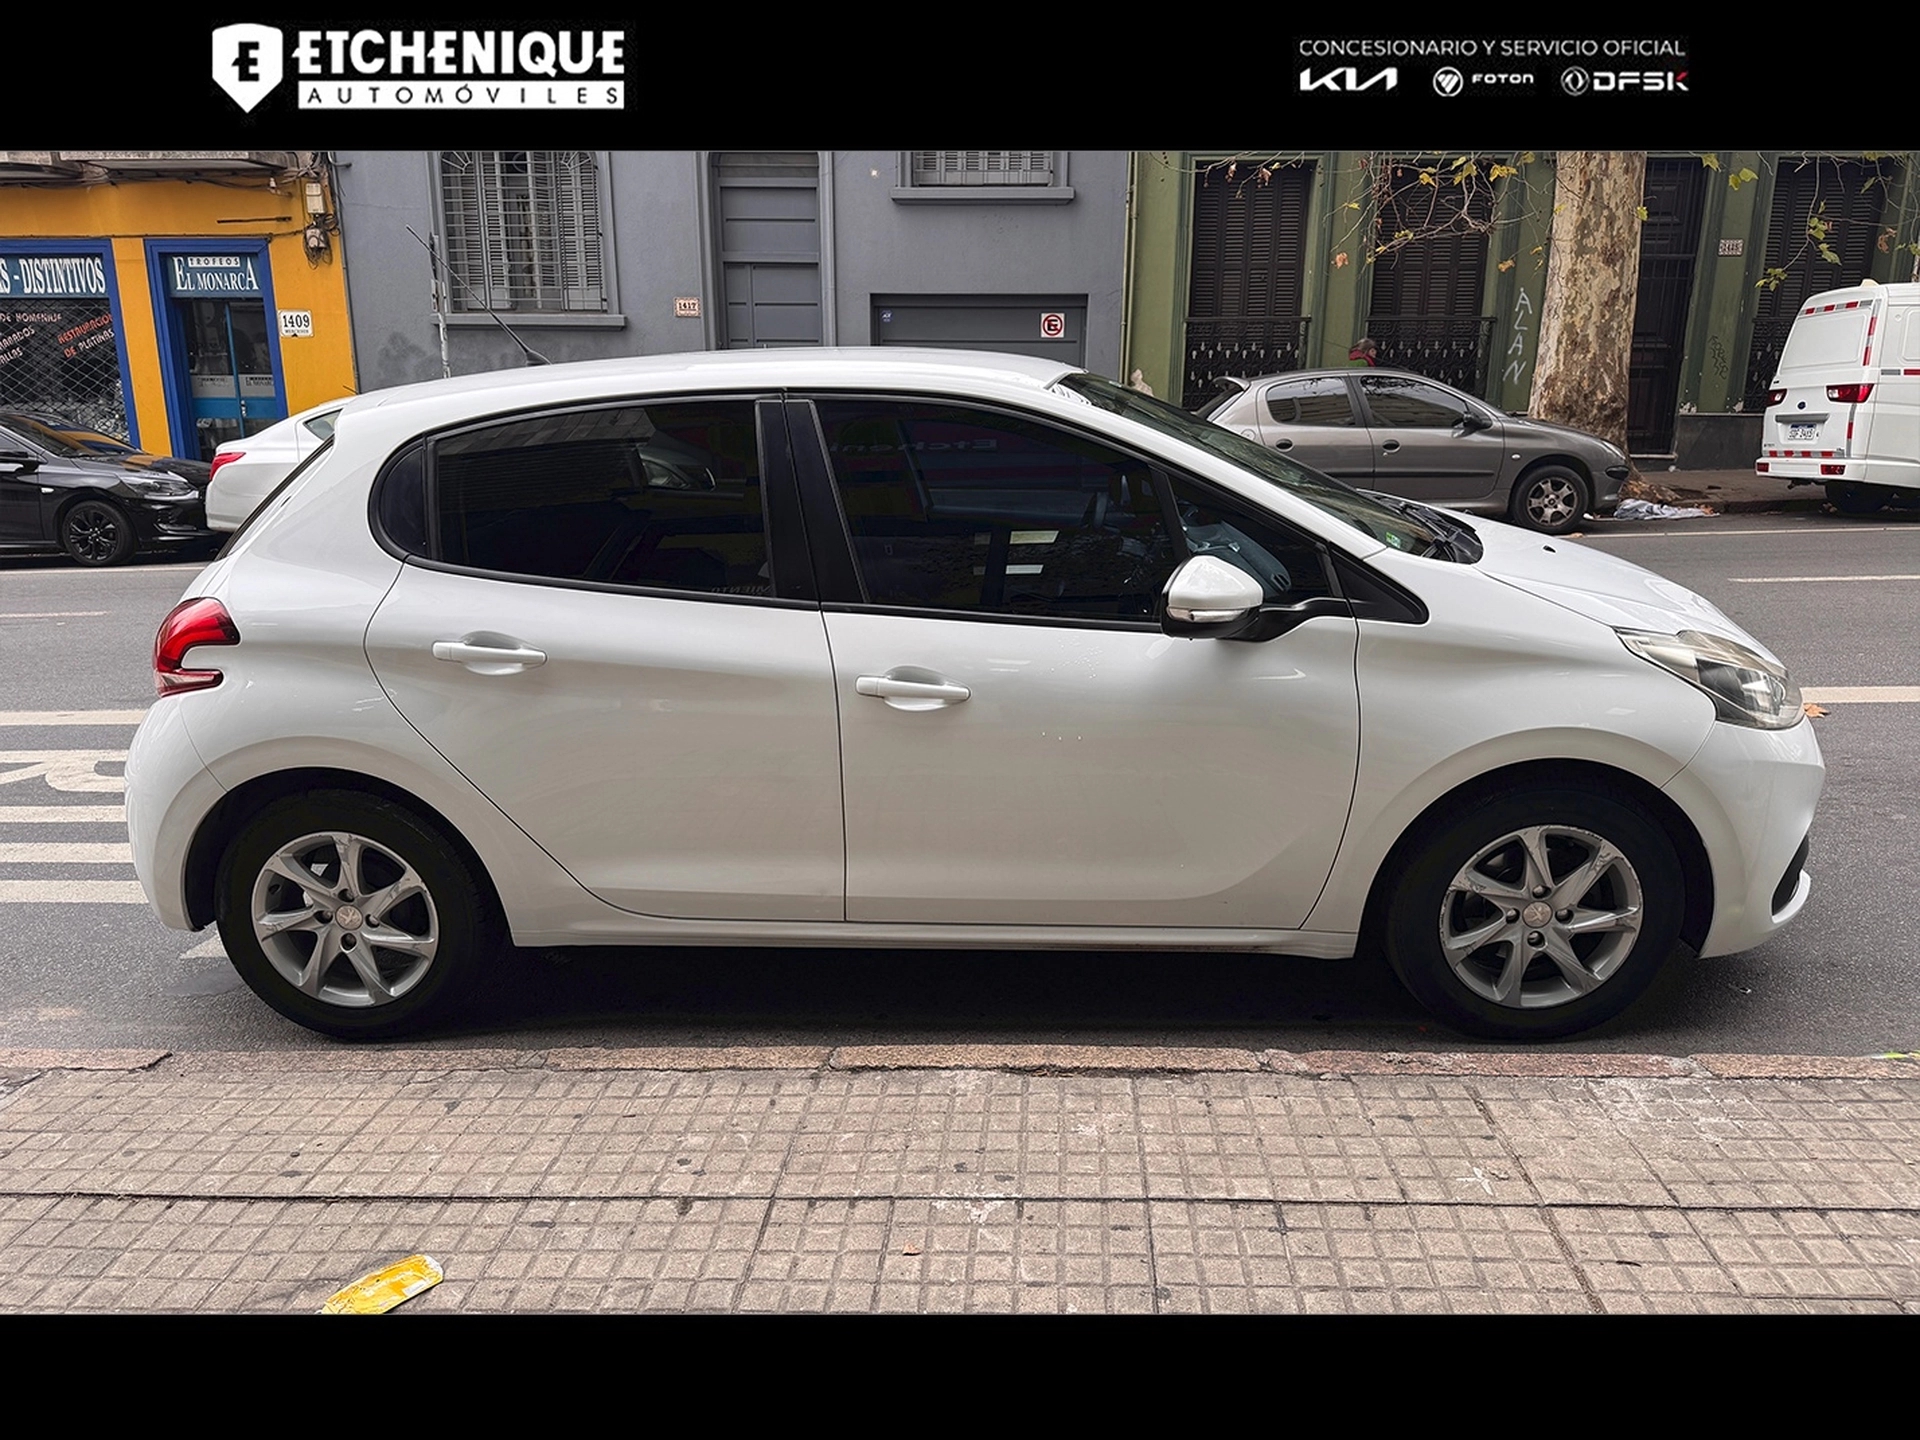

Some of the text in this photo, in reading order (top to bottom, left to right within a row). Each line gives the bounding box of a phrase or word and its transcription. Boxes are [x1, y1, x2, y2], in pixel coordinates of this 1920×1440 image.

[19, 257, 105, 294] DISTINTIVOS
[190, 258, 239, 266] TROFEOS
[197, 257, 259, 291] MONARCA
[283, 314, 310, 328] 1409
[1504, 287, 1532, 385] ALAN
[63, 328, 115, 359] DE PLATINAS
